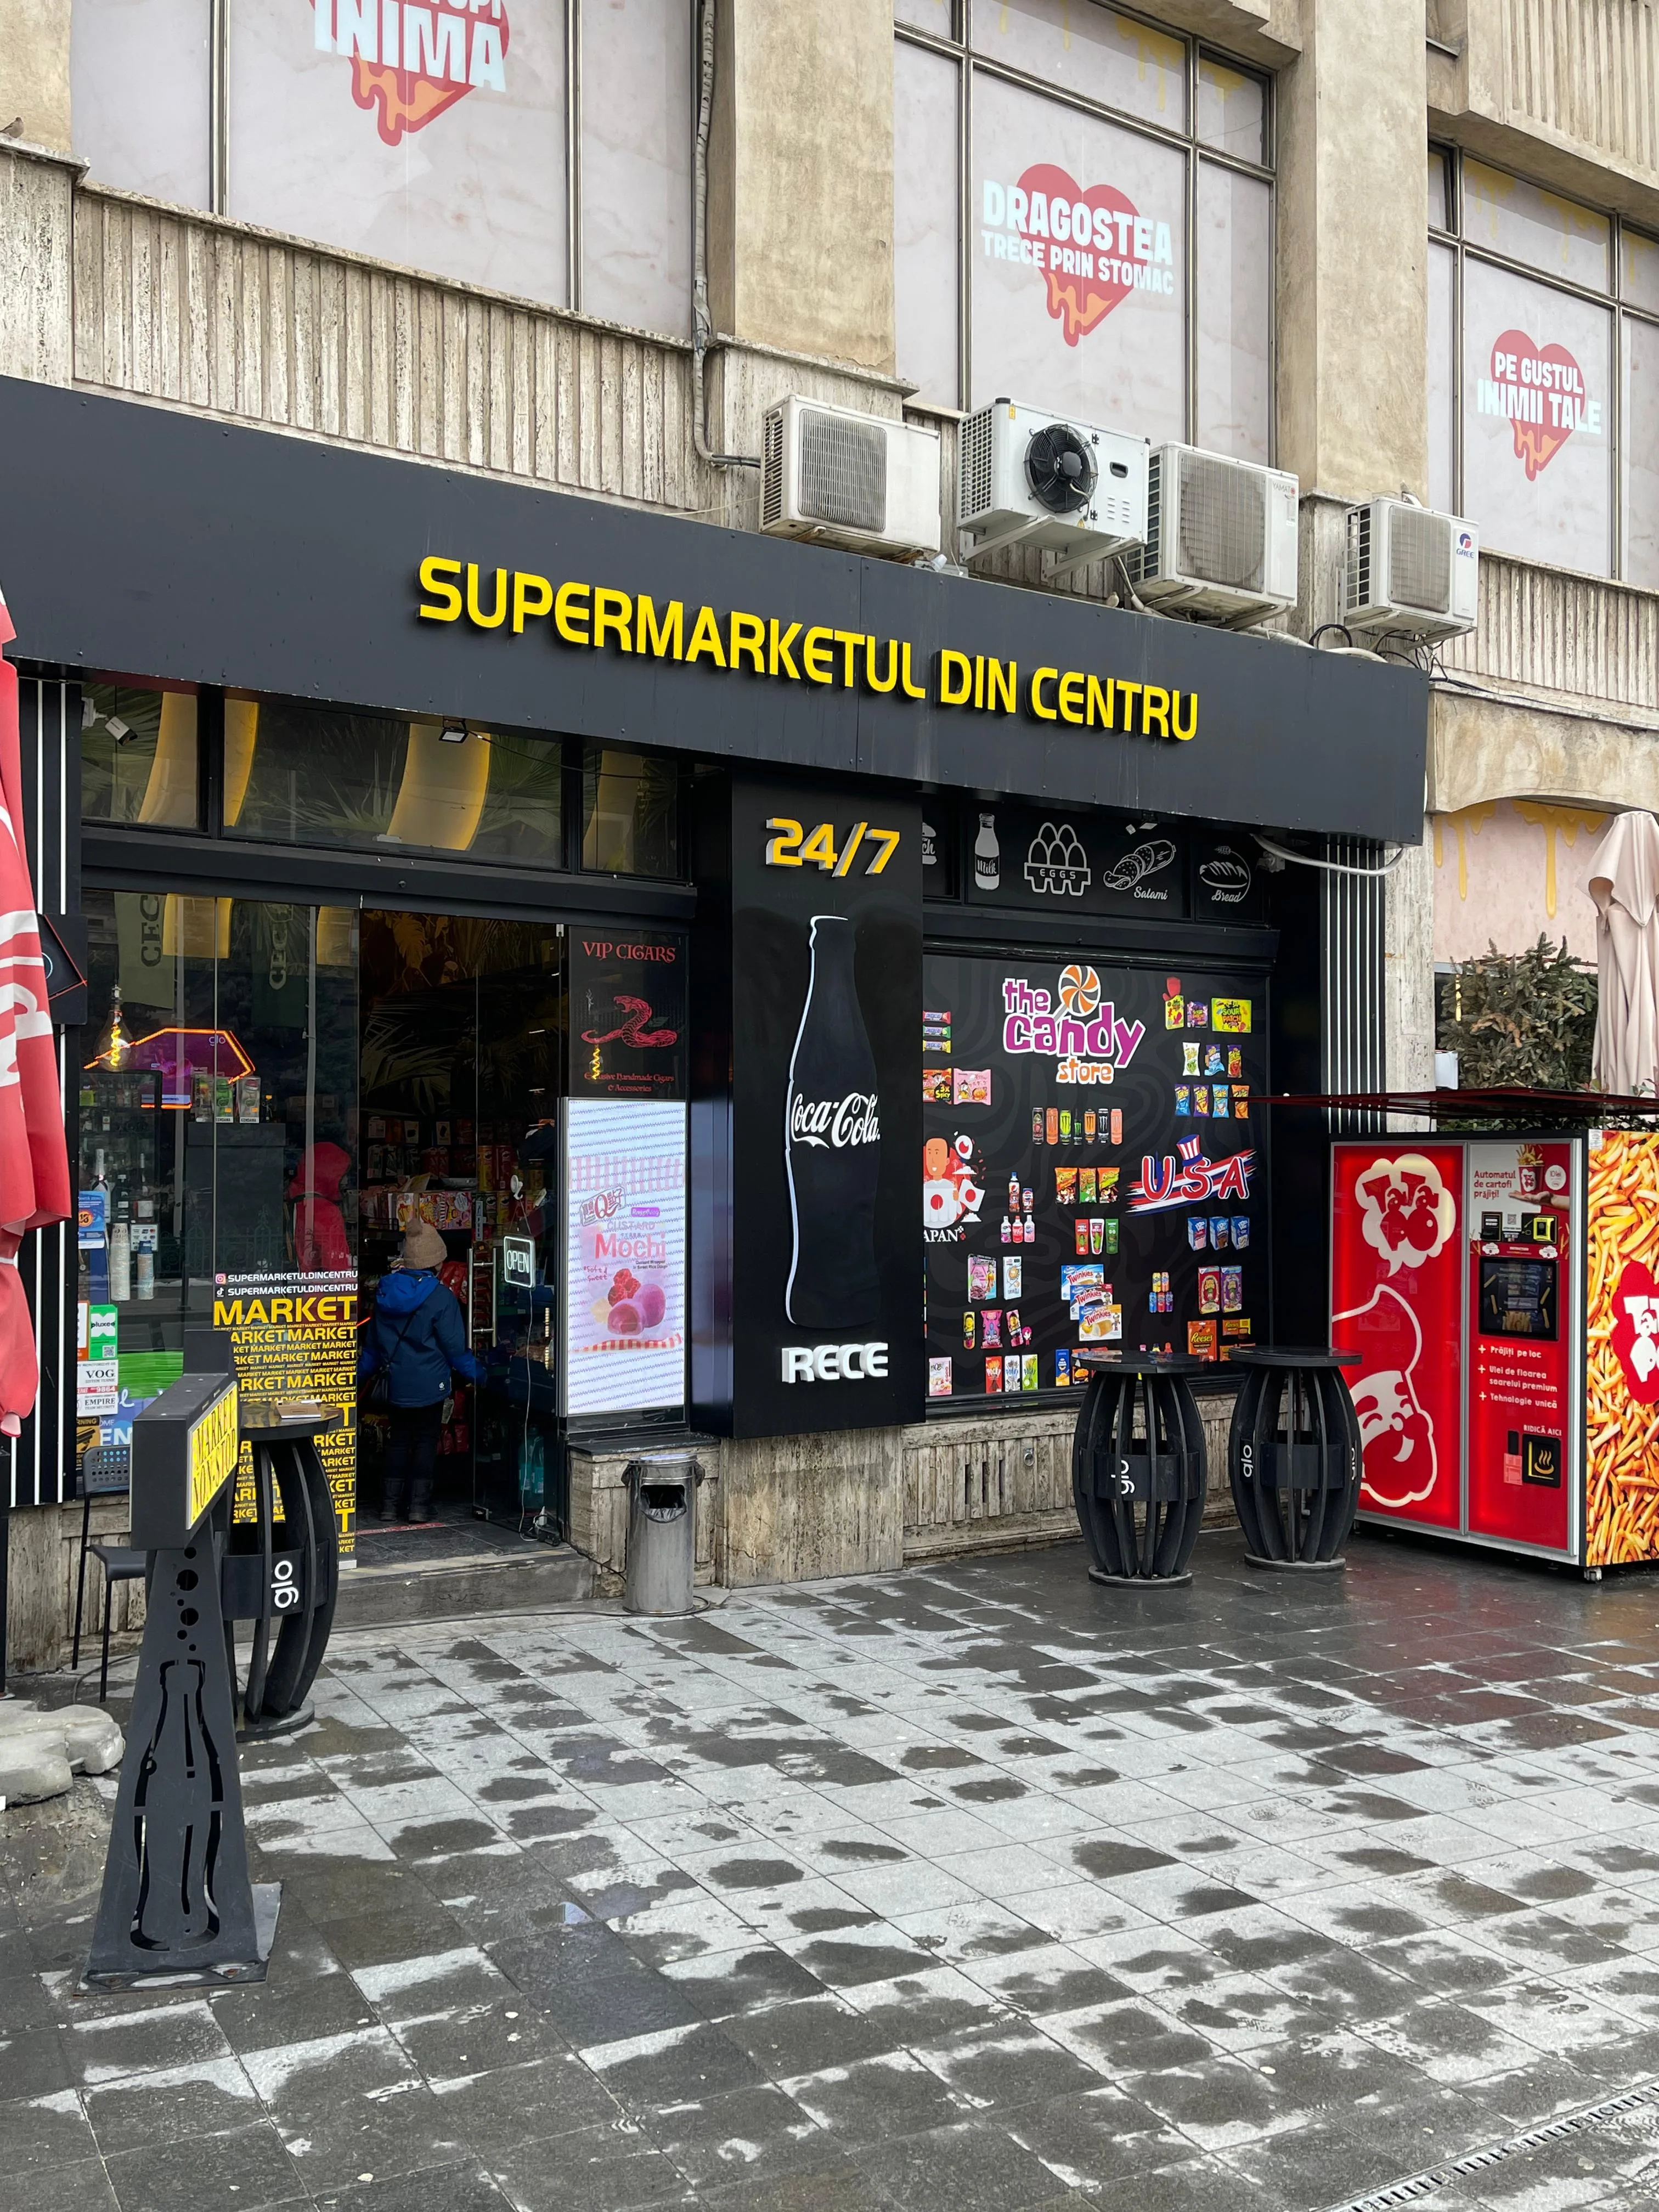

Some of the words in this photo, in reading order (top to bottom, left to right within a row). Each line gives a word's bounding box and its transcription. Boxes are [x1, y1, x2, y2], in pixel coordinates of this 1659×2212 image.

[315, 0, 506, 92] INIMA
[983, 180, 1173, 265] DRAGOSTEA
[981, 230, 1045, 268] TRECE
[1051, 245, 1093, 279] PRIN
[1098, 257, 1173, 295] STOMAC
[1496, 352, 1517, 381] PE
[1521, 358, 1583, 394] GUSTUL
[1477, 379, 1543, 424] INIMII
[1549, 393, 1601, 435] TALE
[1457, 548, 1474, 558] GREE
[419, 556, 925, 698] SUPERMARKETUL
[941, 649, 1017, 713] DIN
[1031, 667, 1198, 741] CENTRU
[766, 817, 900, 877] 24/7
[977, 859, 997, 875] Milk
[1040, 868, 1076, 879] EGGS
[1133, 886, 1168, 901] Salami
[1211, 889, 1242, 903] Bread
[582, 941, 613, 961] VIP
[616, 943, 676, 963] CIGARS
[1003, 978, 1051, 1014] the
[1057, 1057, 1113, 1084] store
[791, 1092, 880, 1149] Coca-Cola
[1142, 1156, 1249, 1200] USA
[1474, 1170, 1516, 1179] Automatul
[923, 1228, 959, 1243] APAN
[595, 1232, 665, 1260] Mochi
[506, 1250, 529, 1273] OPEN
[228, 1271, 358, 1282] SUPERMARKETULDINCENTRU
[1067, 1269, 1093, 1285] Twinkies
[228, 1284, 358, 1296] SUPERMARKETULDINCENTRU
[1075, 1290, 1102, 1306] Twinkies
[214, 1296, 358, 1325] MARKET
[1085, 1310, 1111, 1326] Twinkies
[230, 1330, 285, 1344] ARKET
[287, 1327, 357, 1341] MARKET
[251, 1344, 286, 1353] MARKET
[287, 1342, 321, 1351] MARKET
[1529, 1350, 1542, 1358] loc
[234, 1355, 261, 1365] RKET
[263, 1352, 309, 1363] MARKET
[311, 1350, 356, 1361] MARKET
[782, 1342, 888, 1383] RECE
[1489, 1365, 1503, 1374] Ulei
[1505, 1367, 1515, 1375] de
[1517, 1368, 1547, 1379] floarea
[241, 1376, 285, 1391] RKET
[287, 1373, 356, 1388] MARKET
[1489, 1378, 1521, 1388] soarelui
[1522, 1381, 1557, 1392] premium
[1490, 1392, 1532, 1406] Tehnologie
[1535, 1400, 1557, 1408] unică
[1523, 1424, 1545, 1434] RIDICĂ
[1548, 1427, 1562, 1436] AICI
[314, 1433, 356, 1447] RKET
[321, 1447, 356, 1456] MARKET
[321, 1456, 356, 1466] ARKET
[1240, 1445, 1254, 1477] glo
[330, 1479, 355, 1493] KET
[335, 1499, 355, 1509] KET
[271, 1560, 298, 1608] glo
